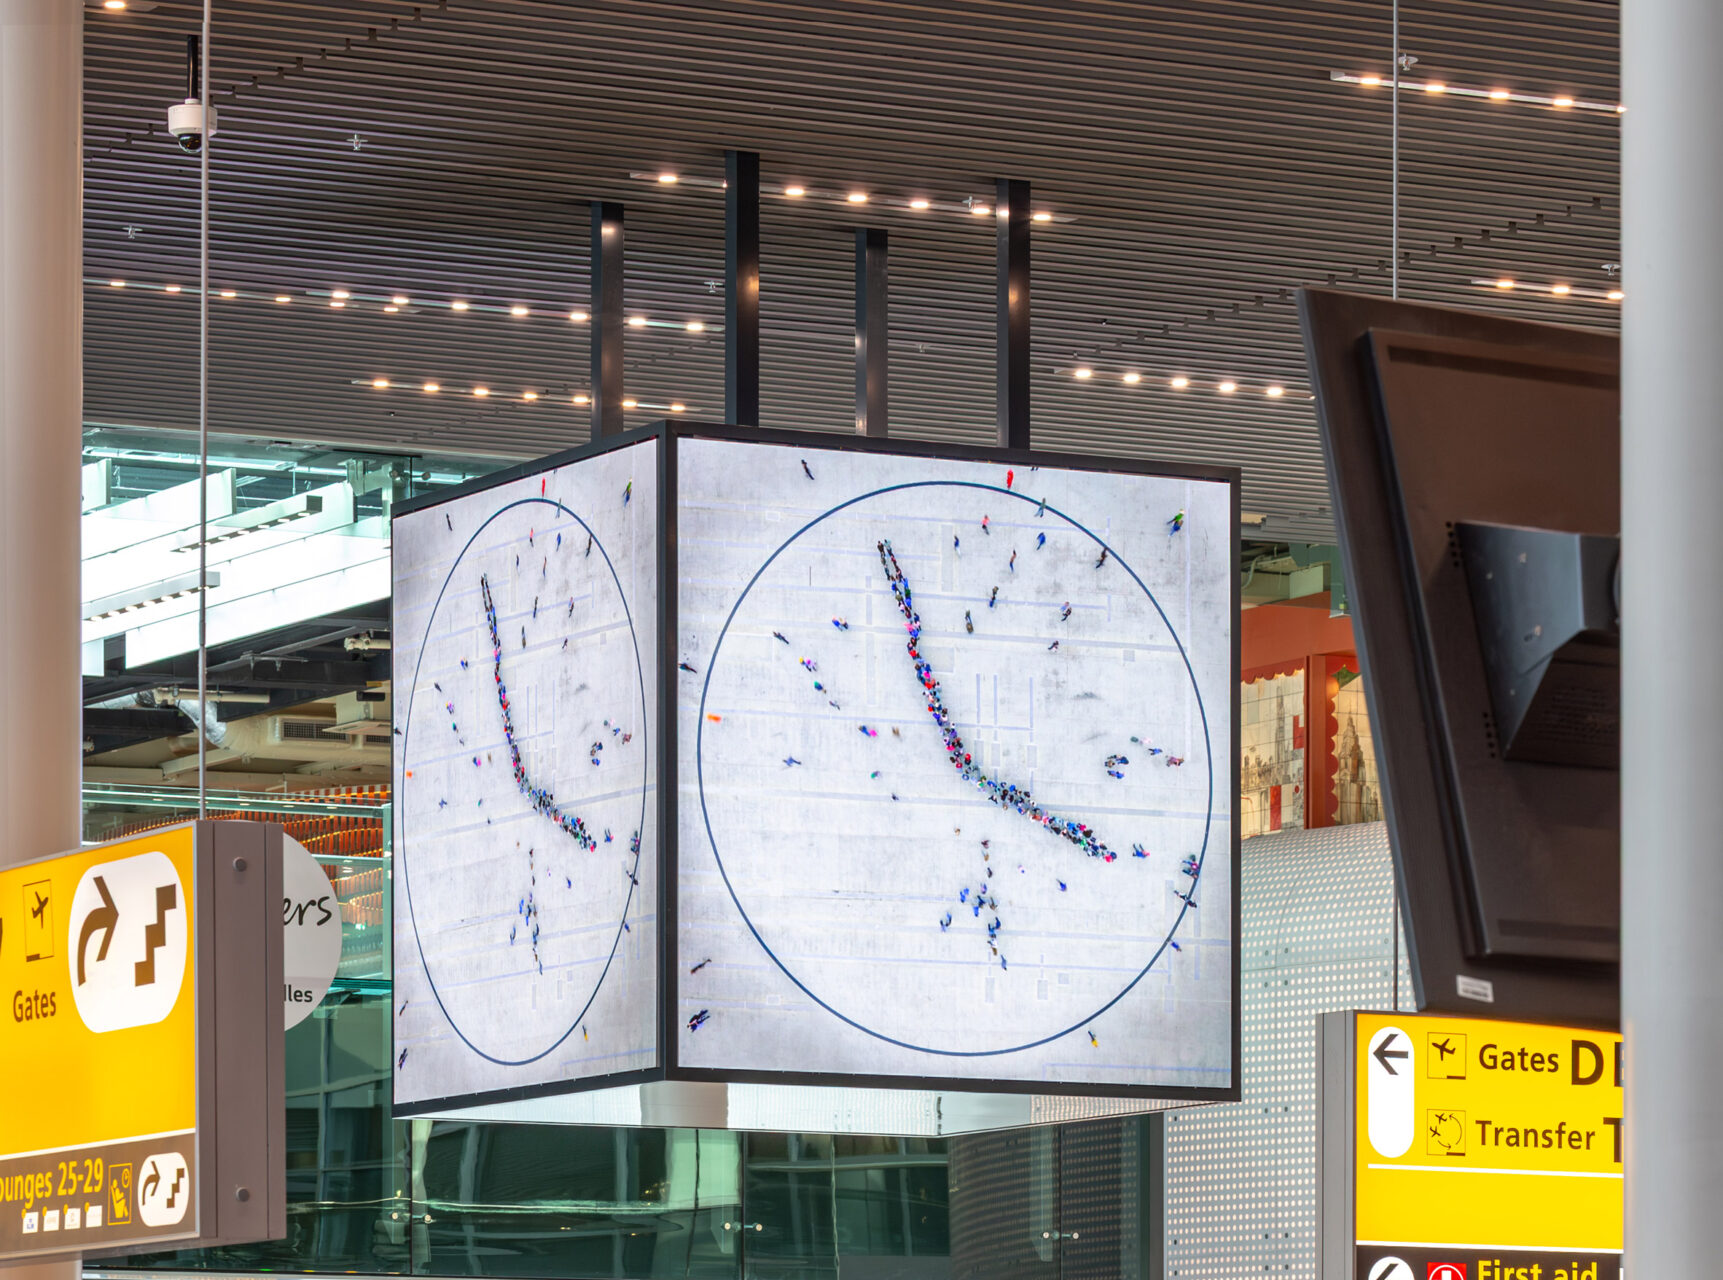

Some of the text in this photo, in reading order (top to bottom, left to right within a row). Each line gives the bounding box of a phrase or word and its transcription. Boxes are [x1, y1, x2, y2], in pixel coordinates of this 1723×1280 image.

[13, 988, 57, 1023] Gates
[1478, 1043, 1559, 1073] Gates
[1475, 1119, 1596, 1151] Transfer
[57, 1157, 104, 1196] 25-29
